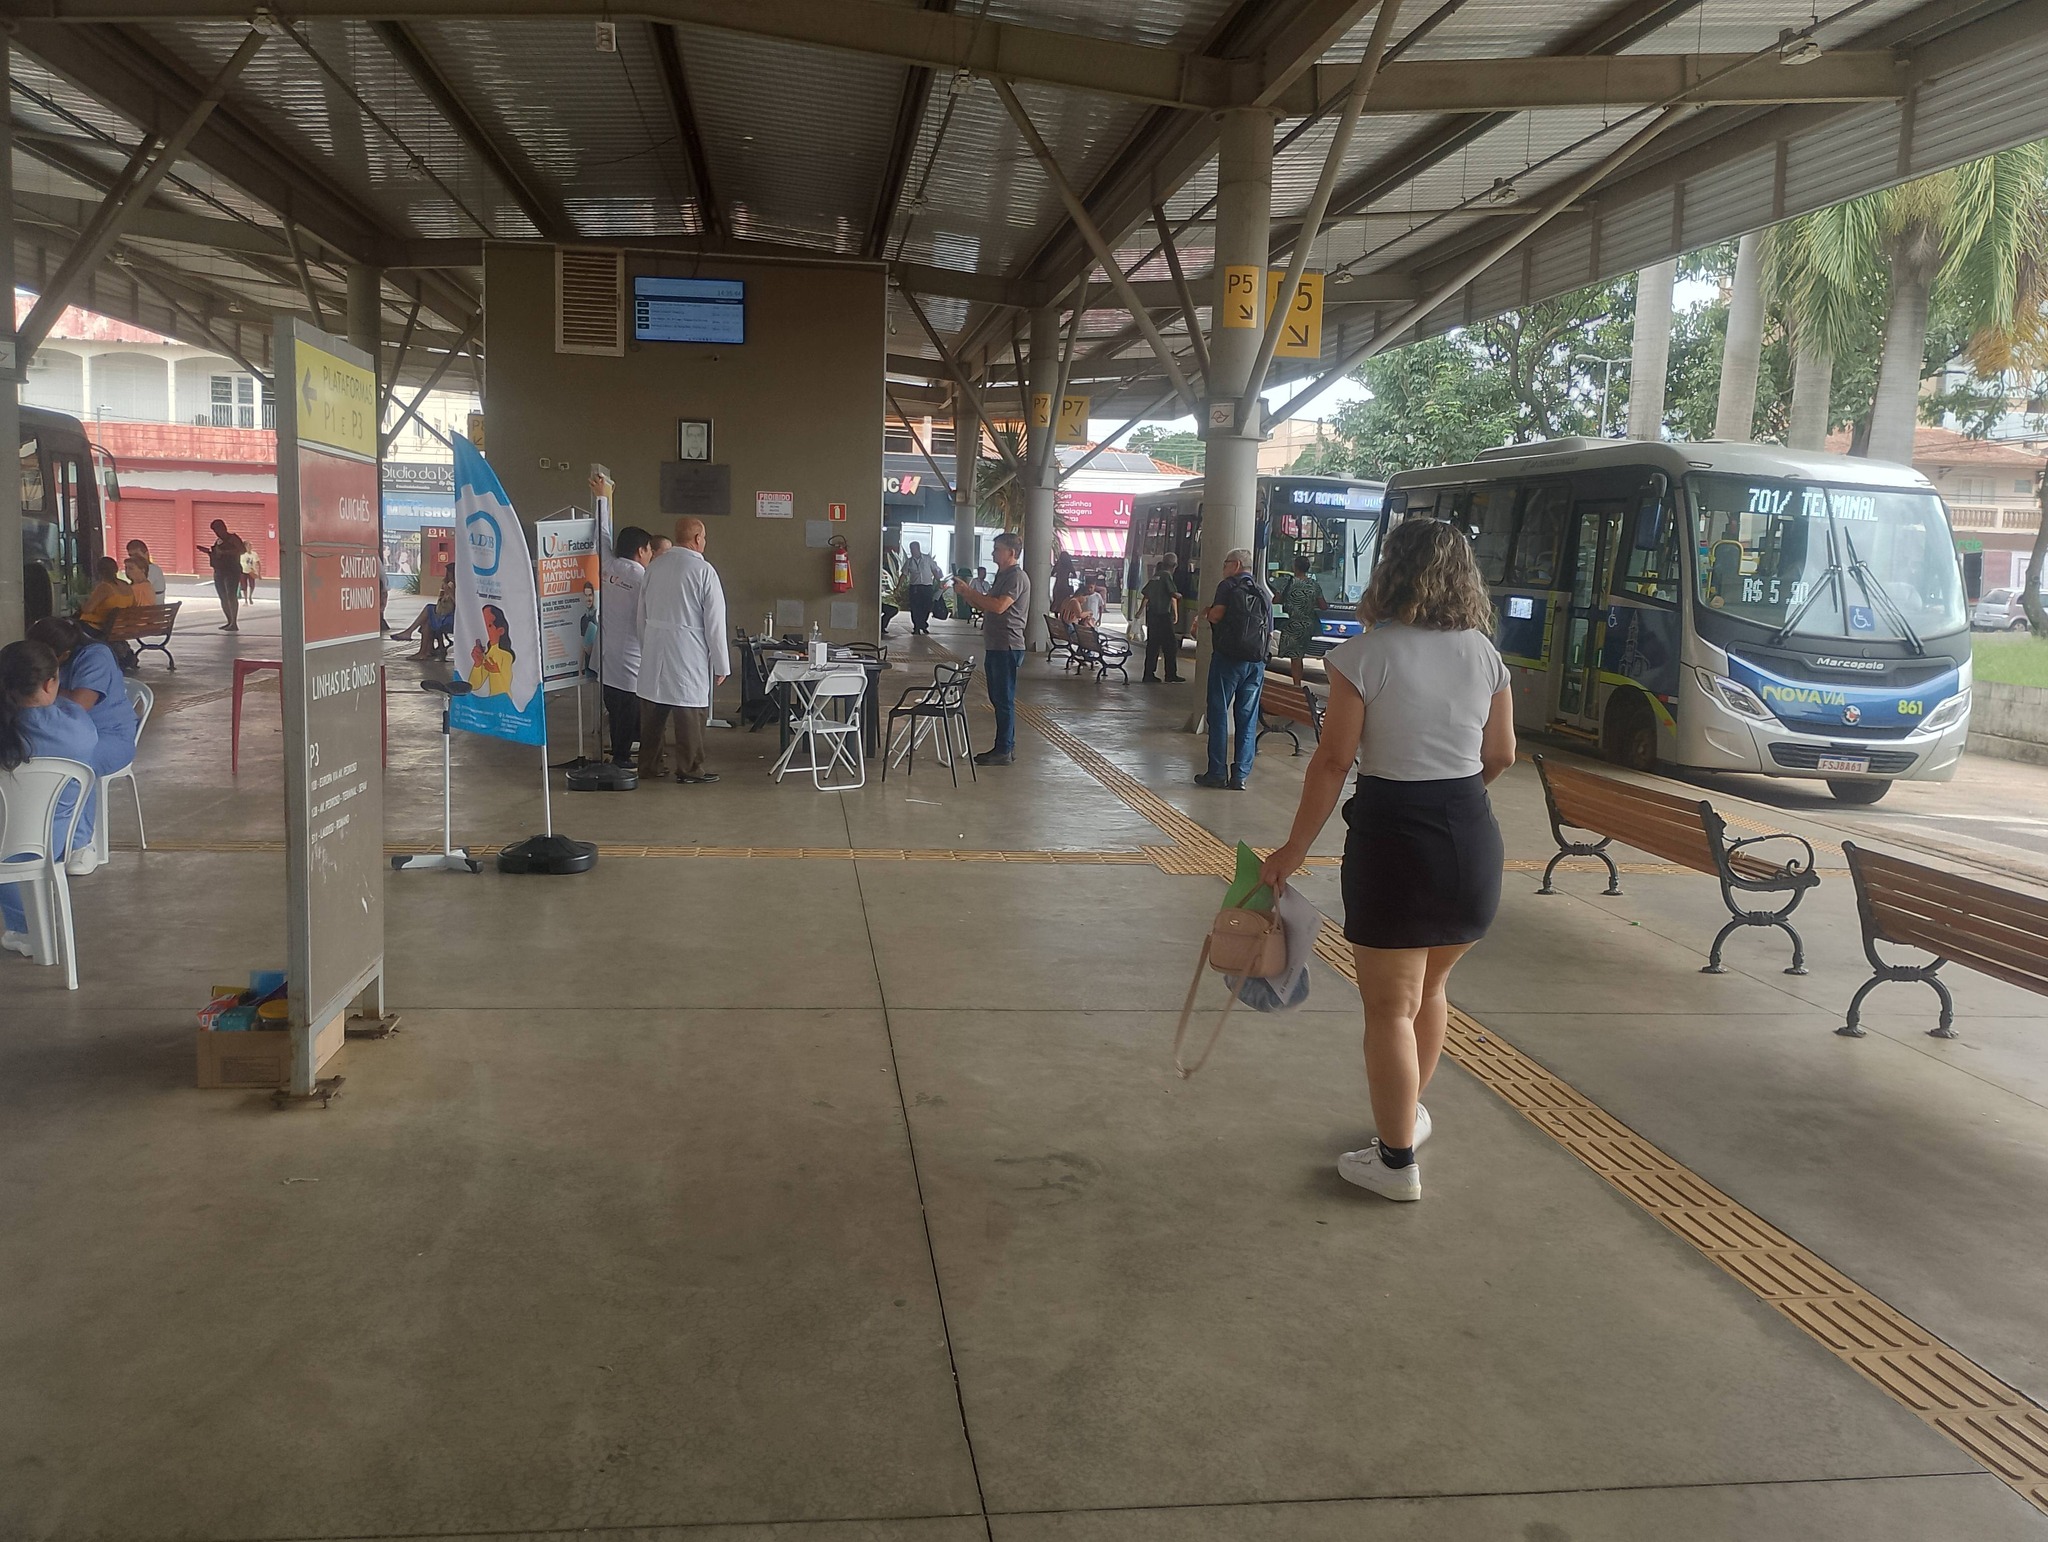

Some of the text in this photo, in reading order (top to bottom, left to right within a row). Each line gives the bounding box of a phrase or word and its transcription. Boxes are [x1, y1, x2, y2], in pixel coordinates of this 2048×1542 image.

[1228, 274, 1253, 294] P5
[323, 365, 373, 406] PLATAFORMAS
[1033, 397, 1048, 408] P7
[1062, 400, 1084, 417] P7
[324, 402, 336, 432] P1
[352, 410, 363, 440] P3
[418, 467, 437, 480] da
[339, 493, 370, 522] GUICHÊS
[759, 493, 790, 501] PROIBIDO
[1748, 488, 1793, 514] 701/
[340, 548, 377, 579] SANITÁRIO
[542, 557, 579, 571] FAÇA SUA
[341, 586, 375, 611] FEMININO
[1742, 578, 1764, 603] R$
[1769, 579, 1781, 604] 5
[1816, 657, 1884, 670] Marcopolo
[312, 660, 376, 700] LINHAS DE ÔNIBUS
[1897, 699, 1923, 715] 861
[310, 742, 320, 768] P3
